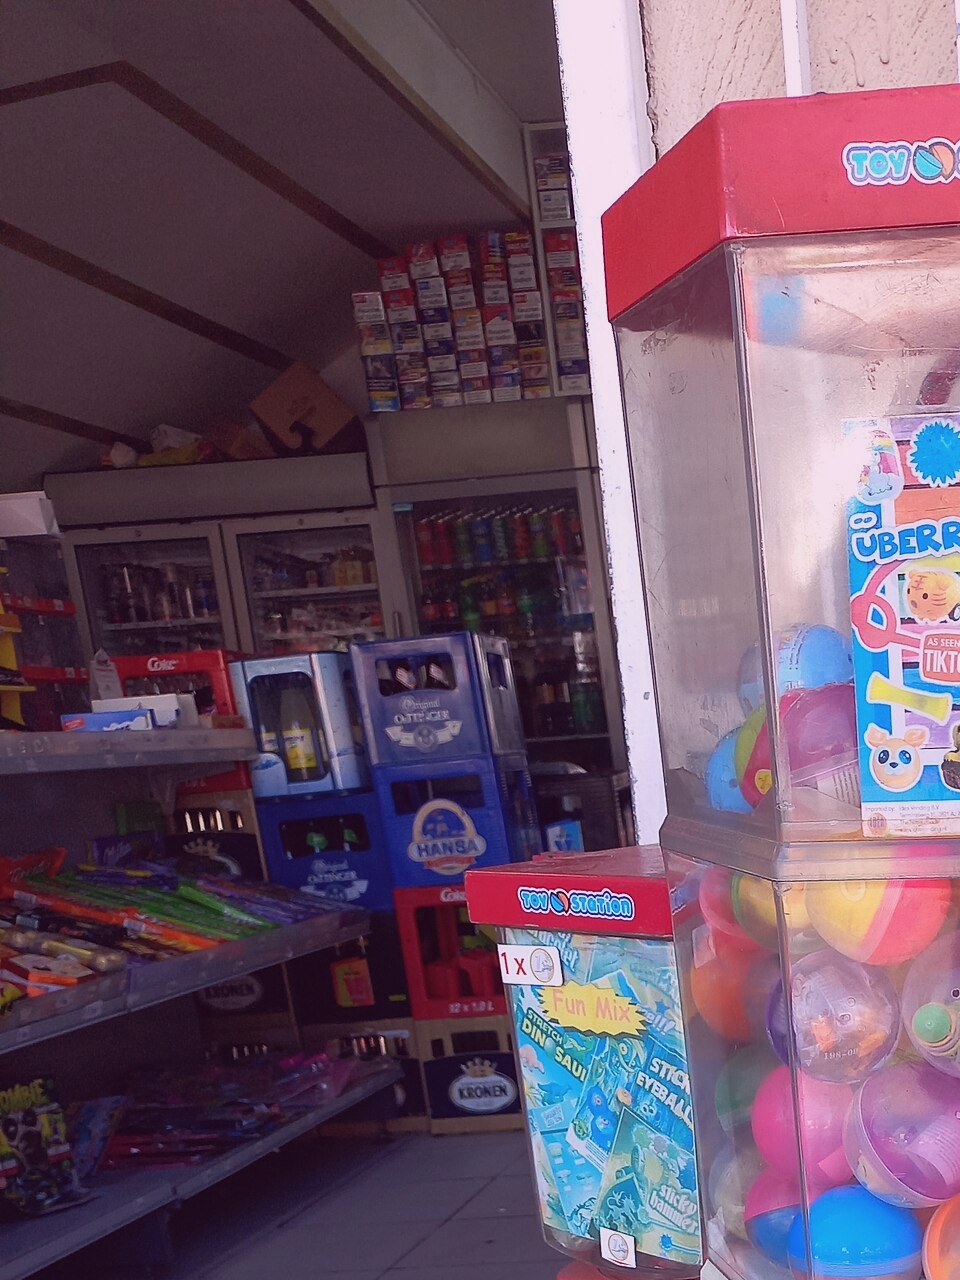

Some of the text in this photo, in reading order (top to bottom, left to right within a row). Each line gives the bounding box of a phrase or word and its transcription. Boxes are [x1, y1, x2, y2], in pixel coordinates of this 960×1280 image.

[927, 637, 939, 646] AS
[940, 638, 960, 648] SEEN
[416, 839, 482, 858] HANSA
[500, 951, 510, 975] 1
[514, 957, 528, 976] x
[553, 990, 632, 1023] Fun Mix
[527, 1009, 563, 1045] STRETCH
[457, 1084, 508, 1100] KRONEN
